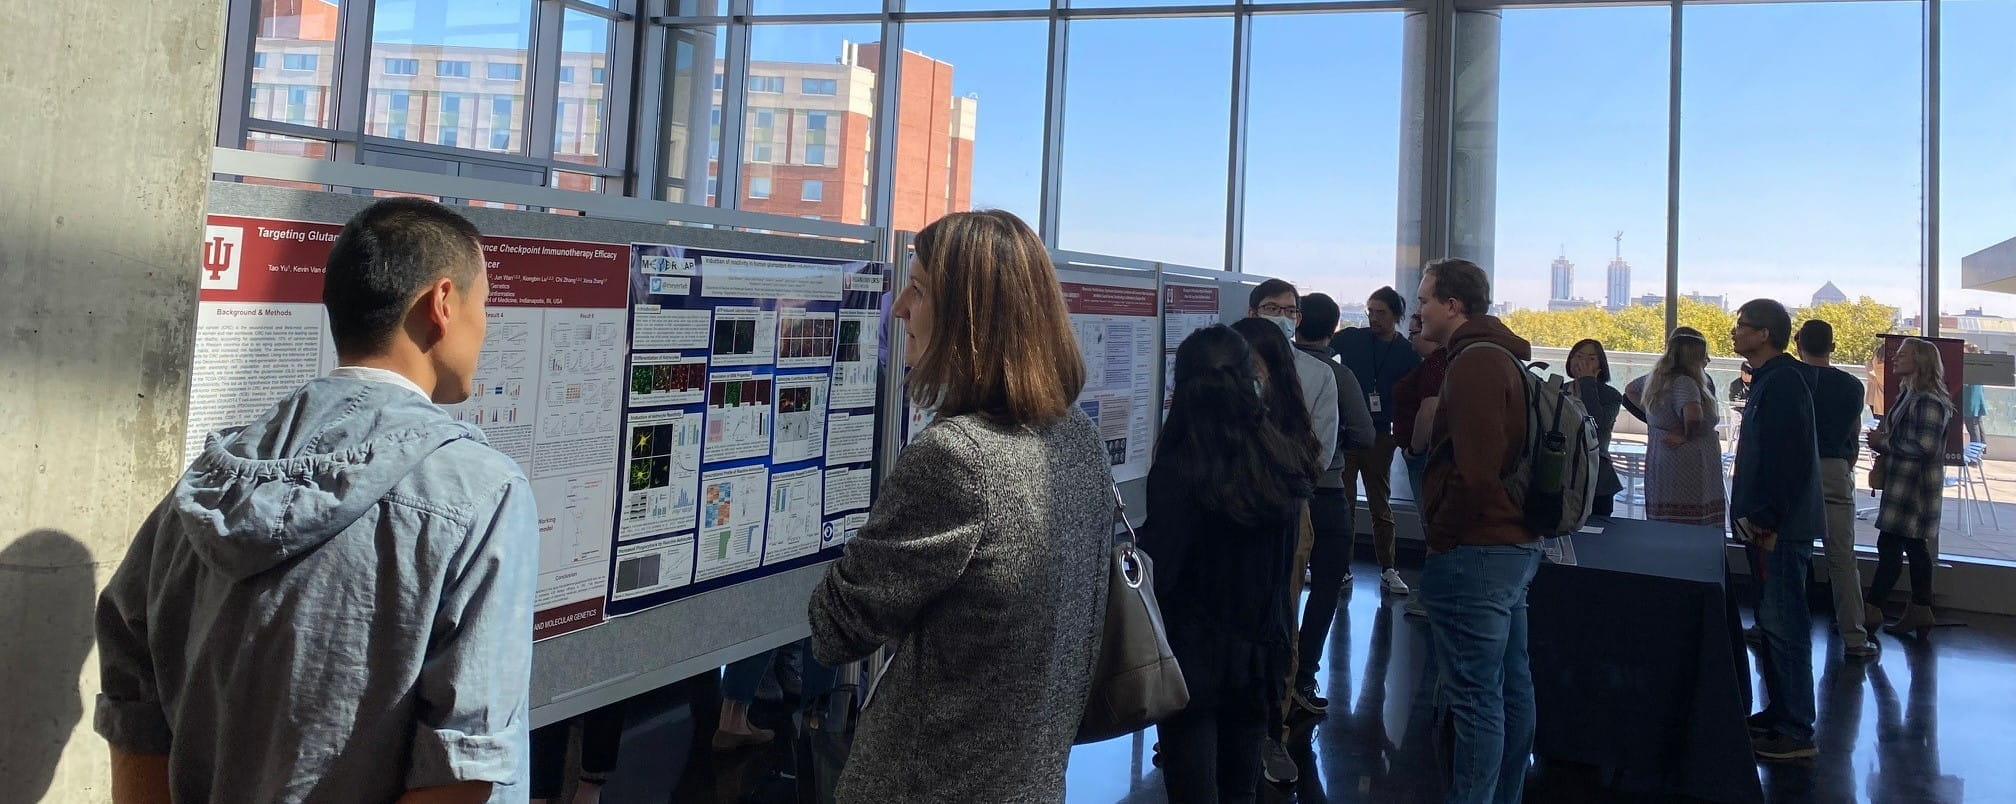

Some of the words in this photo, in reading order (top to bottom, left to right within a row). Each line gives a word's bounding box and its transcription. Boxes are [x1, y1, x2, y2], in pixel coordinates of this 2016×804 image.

[257, 226, 305, 242] Targeting
[499, 243, 541, 255] Checkpoint
[541, 246, 594, 259] Immunotherapy
[594, 249, 617, 260] Efficacy
[268, 264, 279, 272] Tao
[293, 265, 309, 273] Kevin
[310, 265, 321, 273] Van
[216, 308, 257, 317] Background
[264, 309, 292, 317] Methods
[555, 571, 578, 581] Conclusion
[533, 622, 545, 631] AND
[544, 614, 574, 628] MOLECULAR
[573, 608, 597, 621] GENETICS
